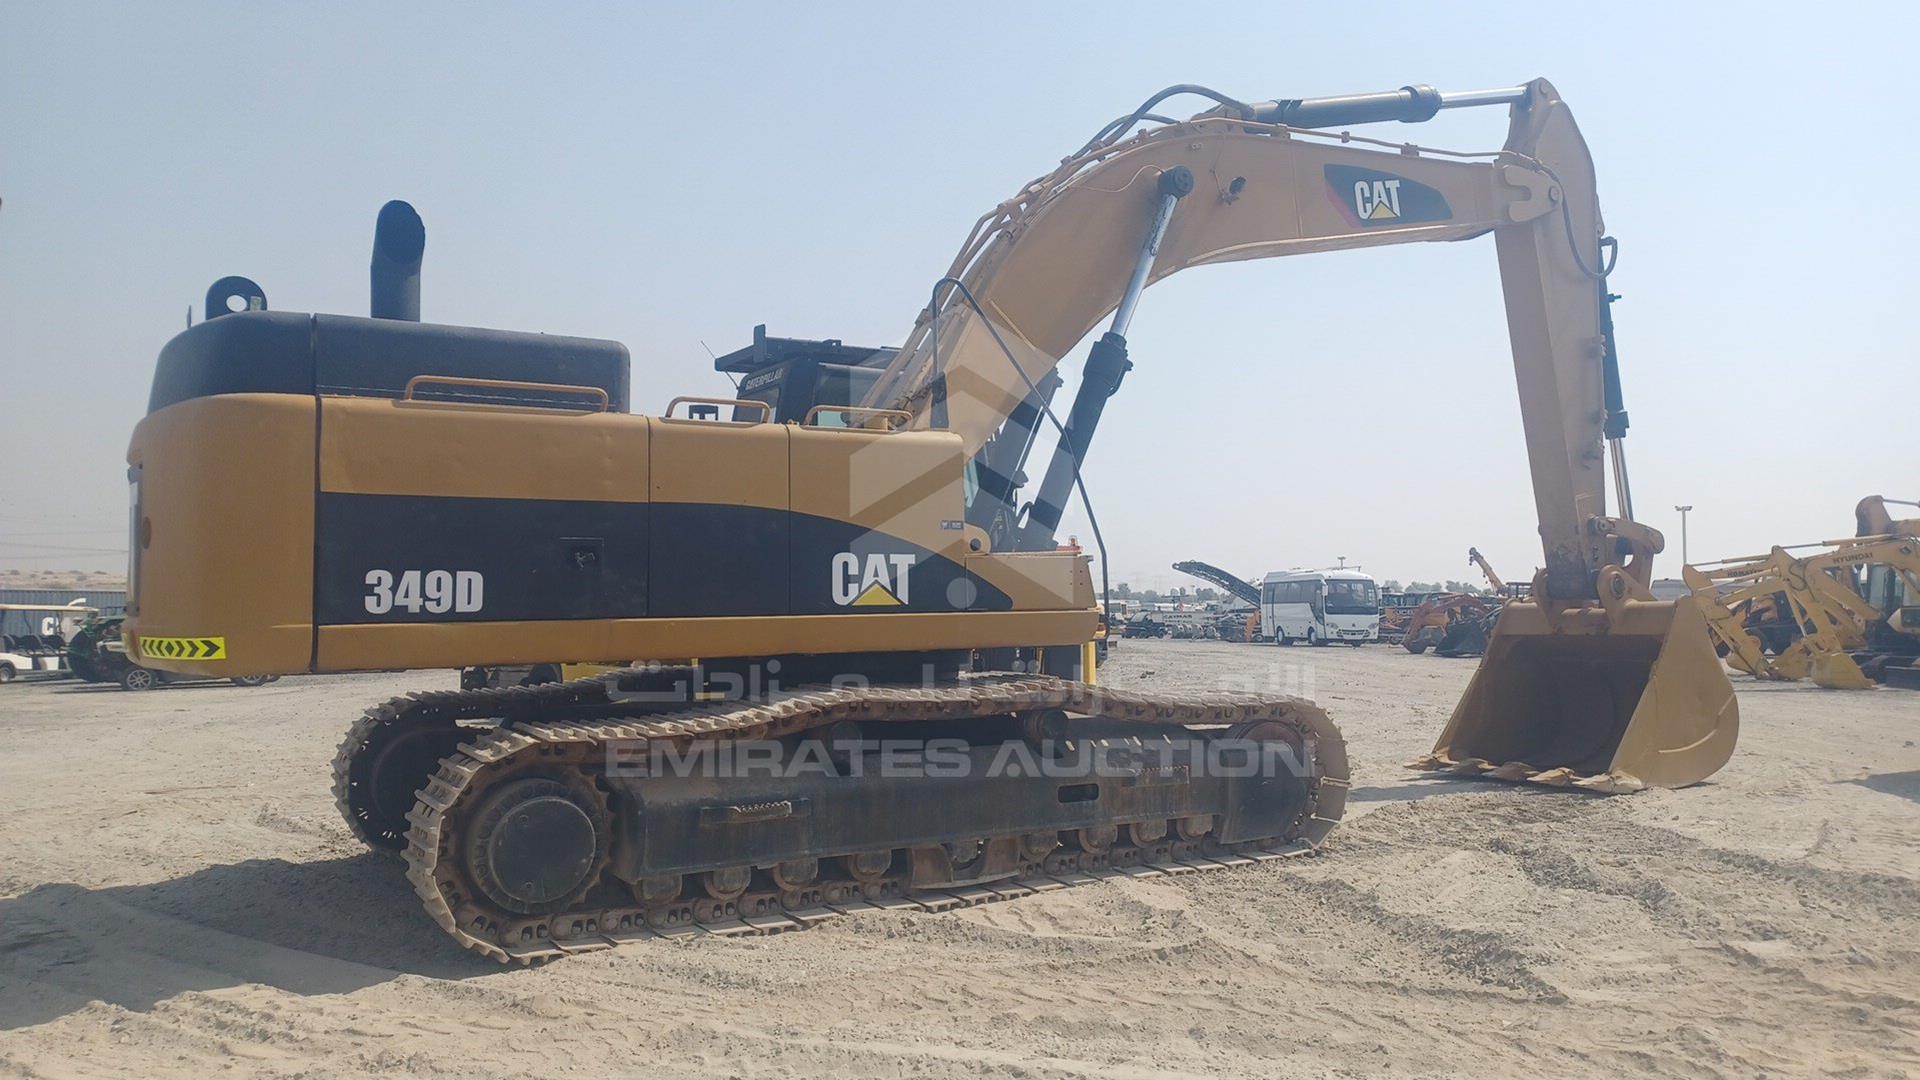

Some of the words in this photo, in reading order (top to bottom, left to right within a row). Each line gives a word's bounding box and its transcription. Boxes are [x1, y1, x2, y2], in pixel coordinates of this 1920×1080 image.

[1354, 179, 1401, 220] CAT
[745, 368, 784, 390] CATERPILLAR
[1832, 552, 1873, 564] HYUNDAI
[364, 569, 484, 614] 349D
[831, 552, 916, 606] CAT
